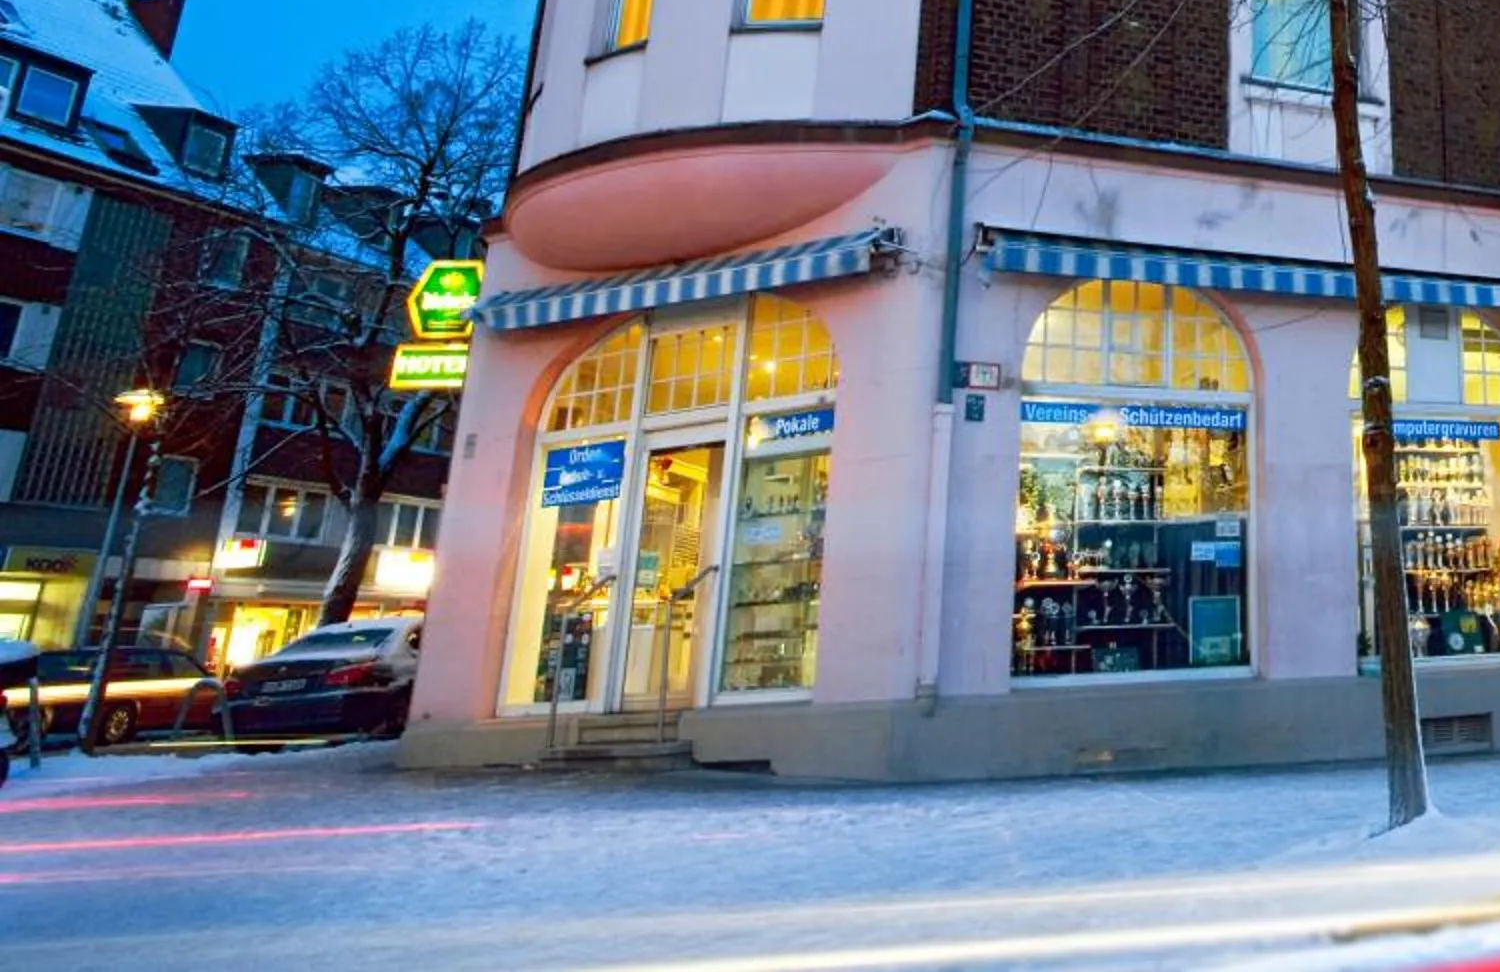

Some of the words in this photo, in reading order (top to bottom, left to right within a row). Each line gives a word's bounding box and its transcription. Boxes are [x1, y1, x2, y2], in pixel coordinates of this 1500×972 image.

[776, 414, 819, 435] Pokale
[1120, 407, 1242, 427] Schützenbedarf
[1392, 420, 1498, 437] mputergravuren
